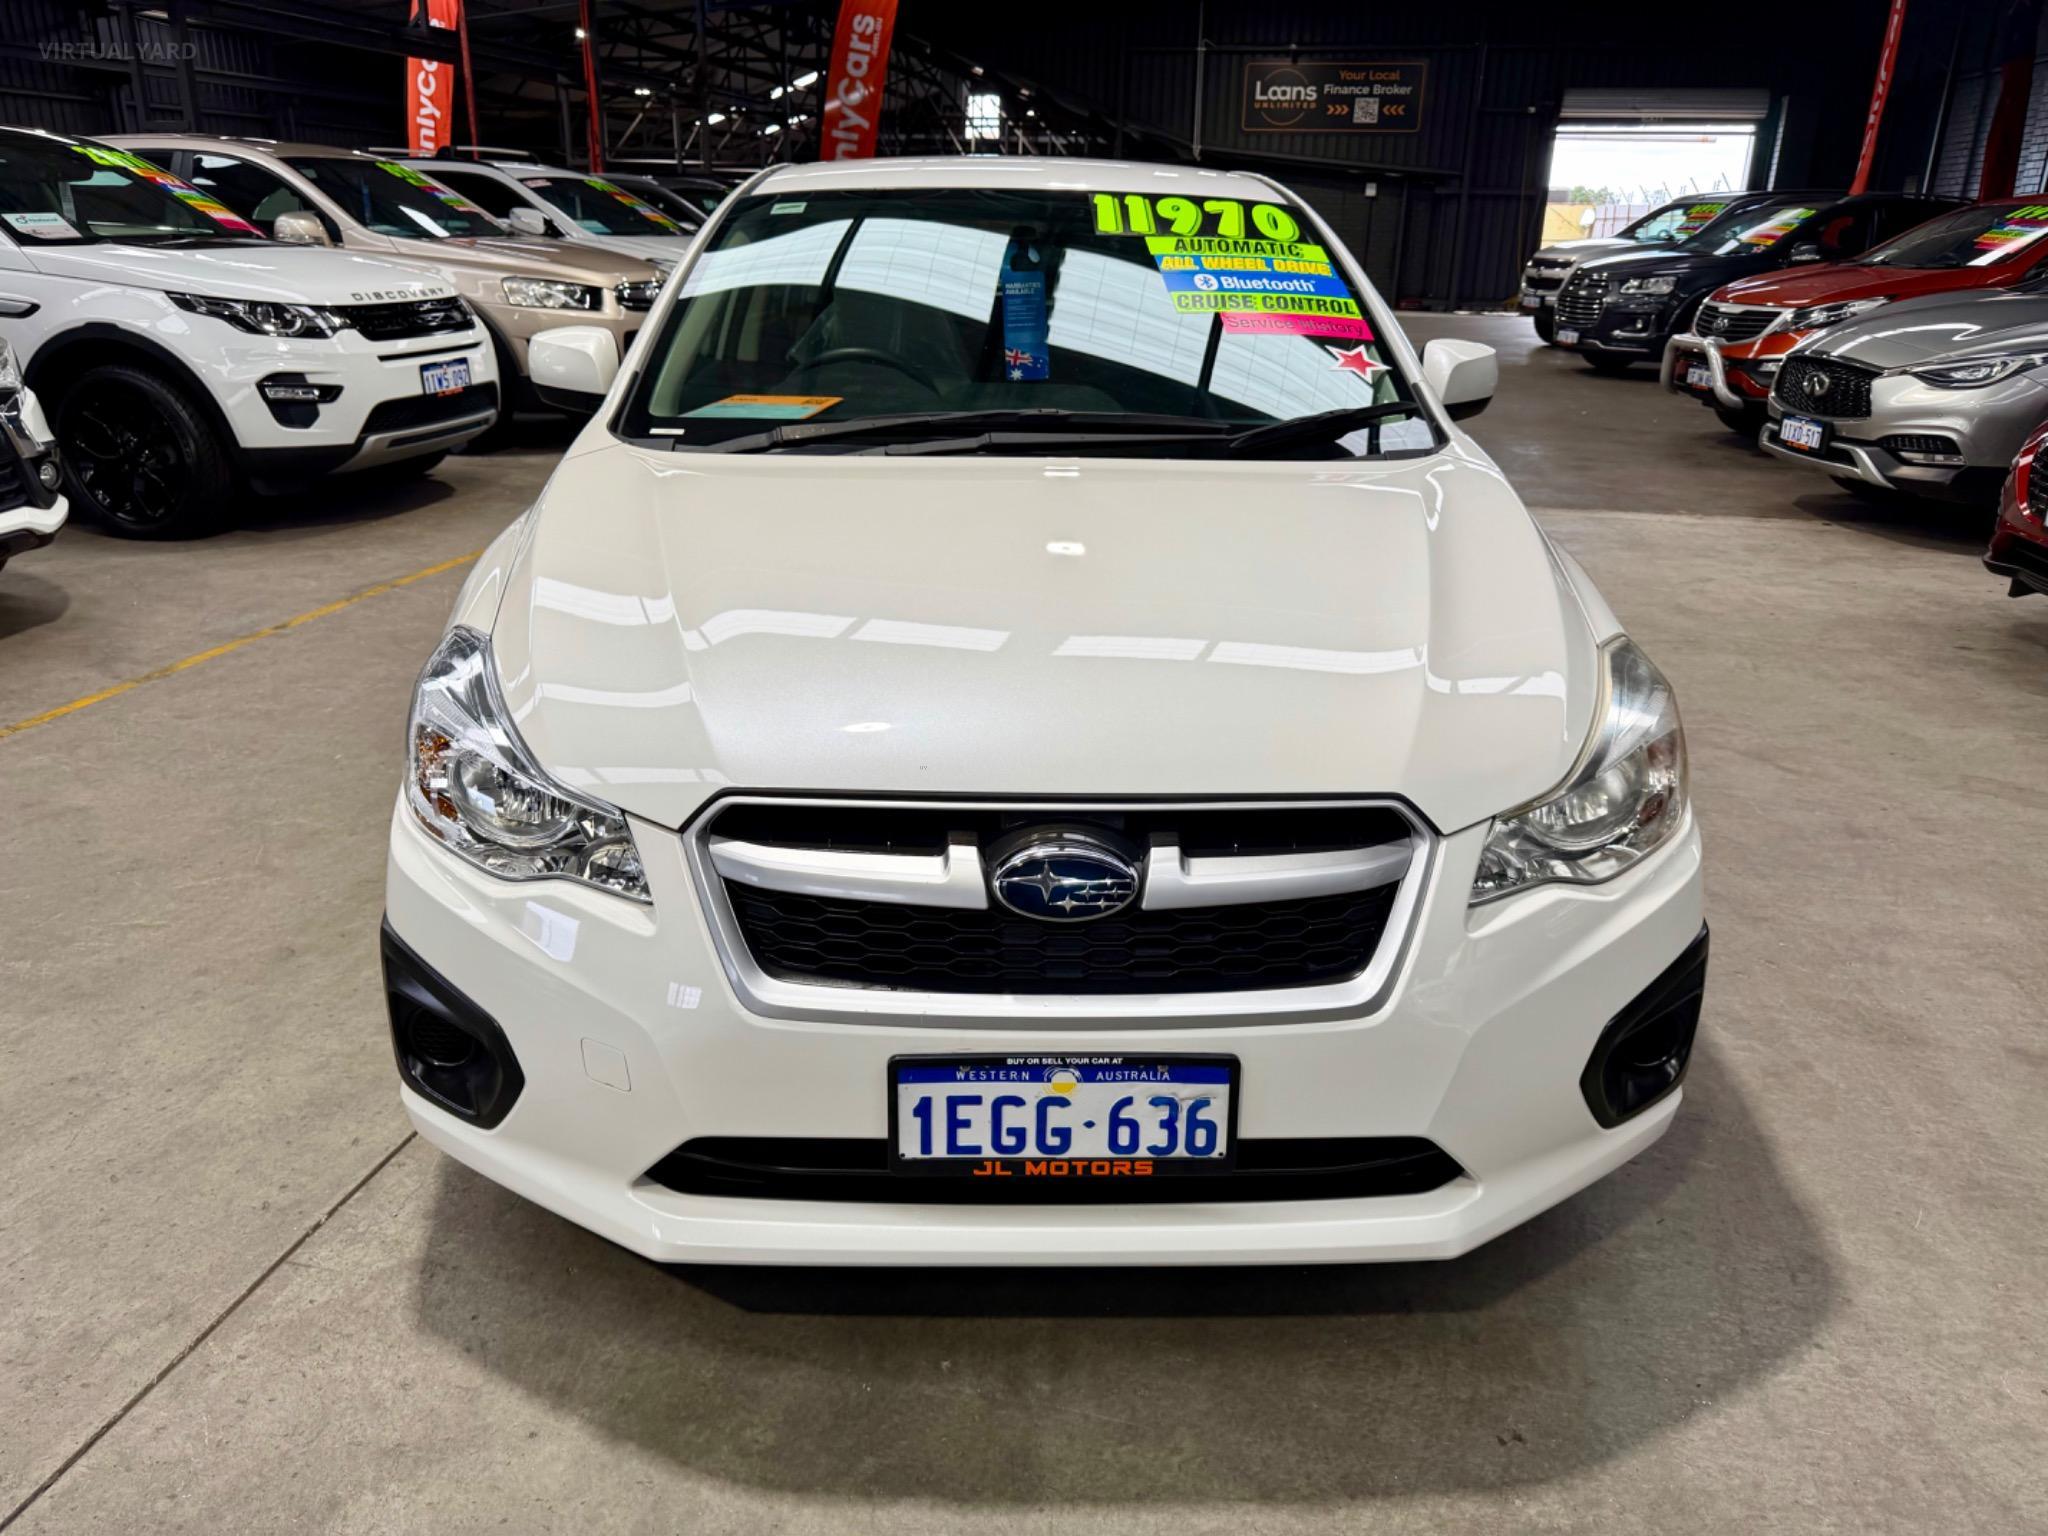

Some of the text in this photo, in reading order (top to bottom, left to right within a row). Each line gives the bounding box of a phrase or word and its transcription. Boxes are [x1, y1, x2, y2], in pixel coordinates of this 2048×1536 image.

[1339, 70, 1400, 81] Your Local
[831, 13, 877, 161] nlyCars
[1254, 80, 1318, 101] Loans
[1323, 84, 1413, 95] Finance Broker
[1093, 194, 1300, 242] 11970
[1174, 238, 1304, 257] AUTOMATIC
[1160, 256, 1333, 277] ALL WHEEL DRIVE
[1220, 274, 1315, 292] Bluetooth
[351, 287, 446, 301] DISCOVERY
[1177, 294, 1356, 315] CRUISE CONTROL
[1226, 315, 1364, 337] Service History
[955, 1070, 1171, 1081] WESTERN AUSTRALIA
[973, 1161, 1153, 1176] JL MOTORS
